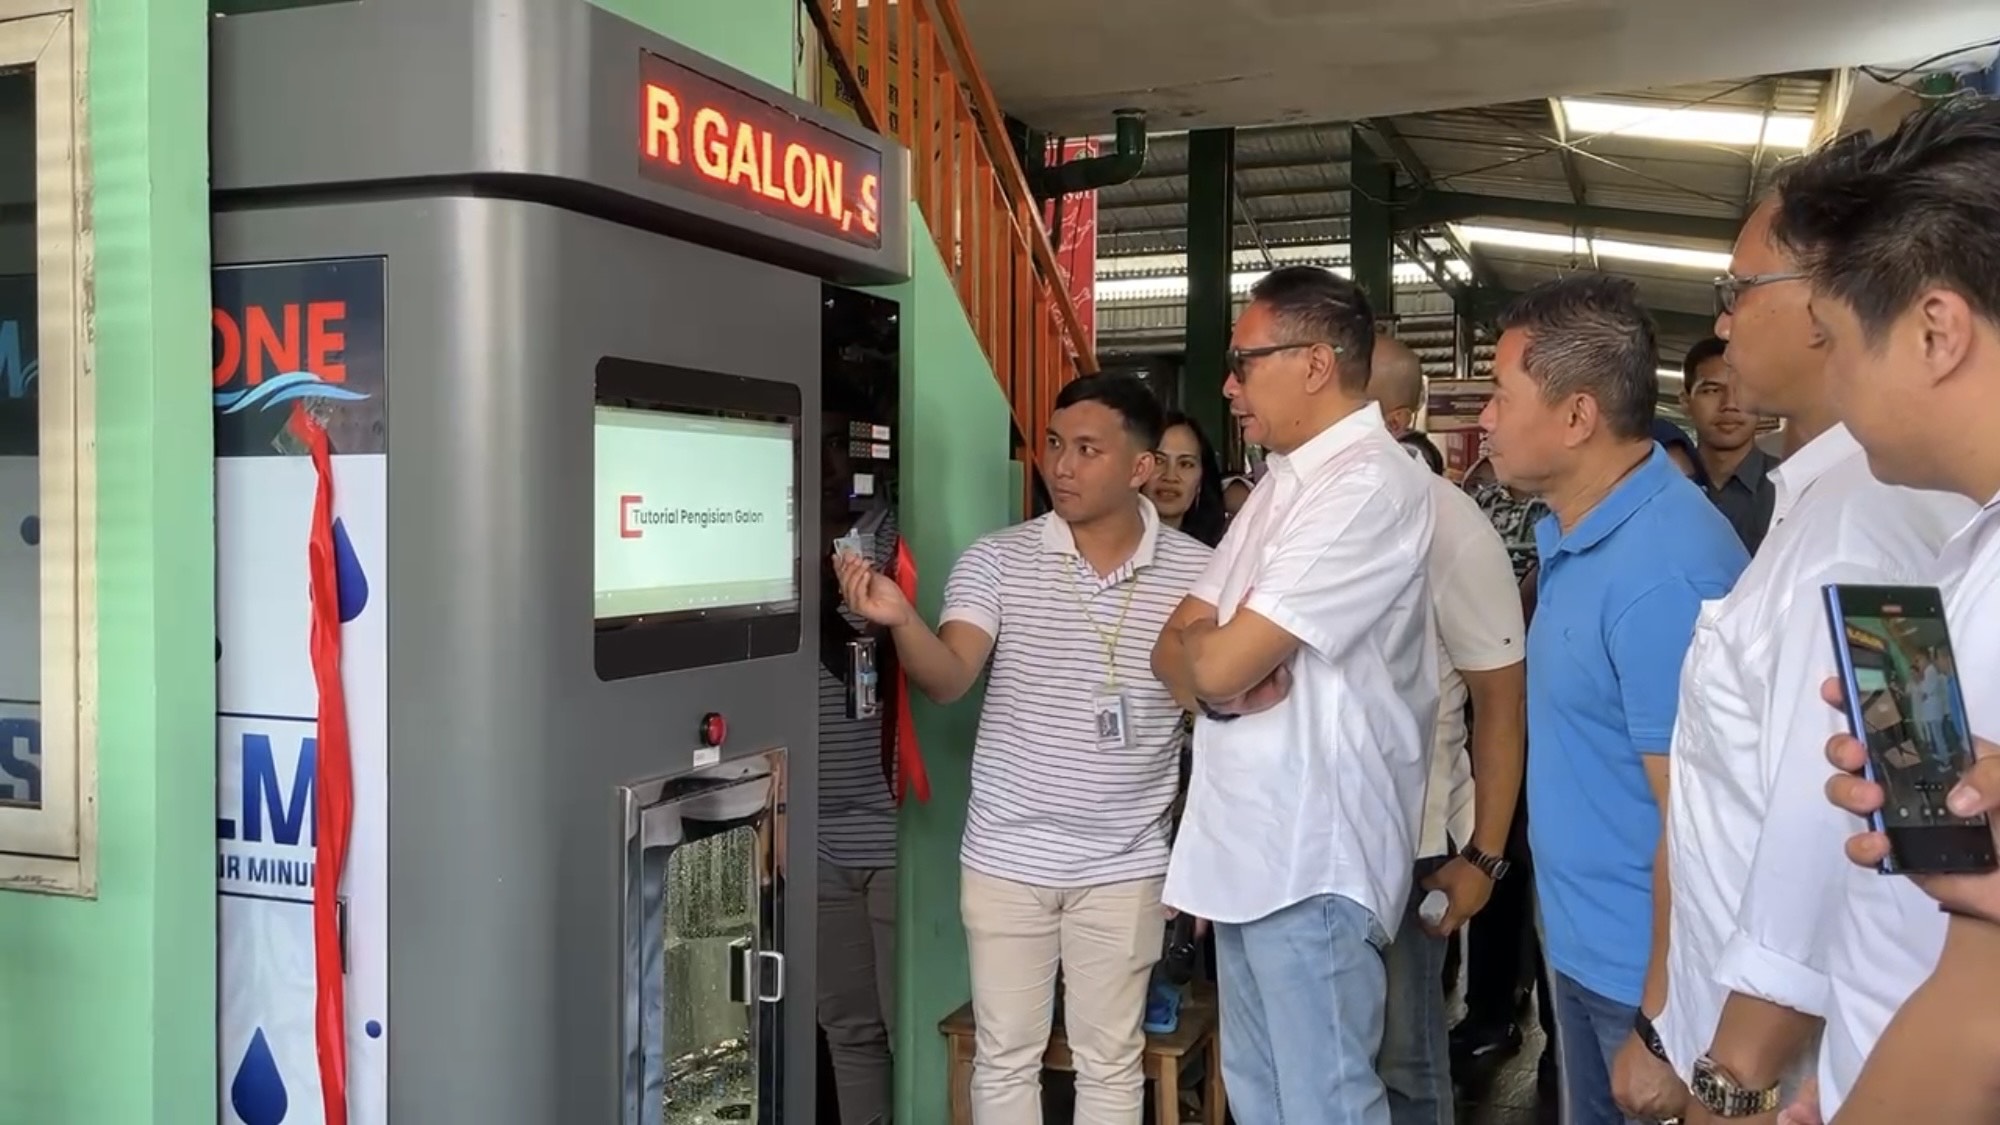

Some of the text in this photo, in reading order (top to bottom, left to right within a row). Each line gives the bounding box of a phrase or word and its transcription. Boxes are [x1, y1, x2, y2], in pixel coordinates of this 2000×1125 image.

[646, 83, 681, 165] R
[693, 107, 853, 232] GALON,
[632, 507, 764, 529] Tutorial Pengisian Galon
[248, 856, 316, 888] MINU
